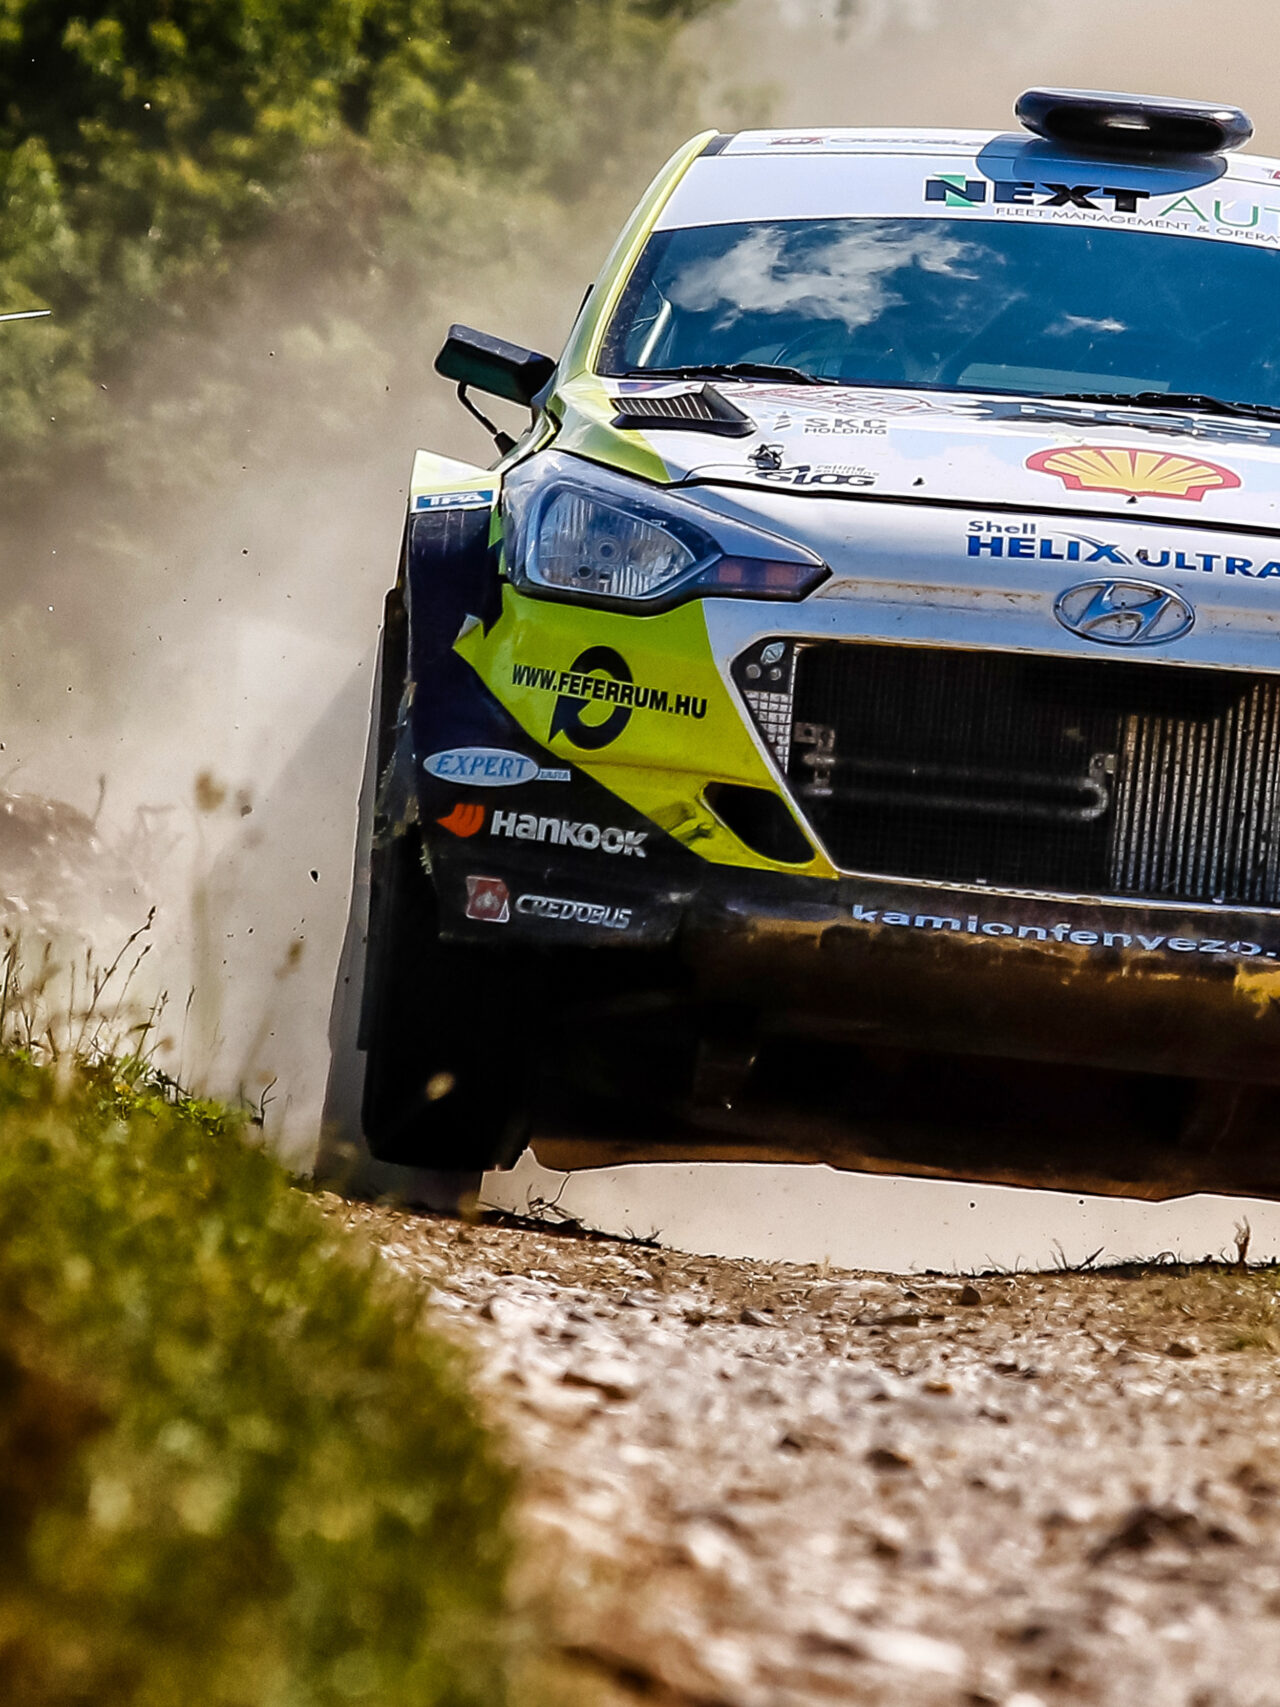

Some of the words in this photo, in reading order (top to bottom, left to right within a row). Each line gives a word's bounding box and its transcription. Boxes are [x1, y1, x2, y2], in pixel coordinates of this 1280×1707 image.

[925, 174, 1151, 213] NEXT
[995, 207, 1044, 218] FLEET
[1051, 208, 1191, 231] MANAGEMENT
[1197, 223, 1210, 233] &
[804, 427, 887, 435] HOLDING
[805, 417, 887, 429] SKC
[967, 519, 1036, 535] Shell
[965, 531, 1134, 566] HELIX
[512, 663, 708, 720] WWW.FEFERRUM.HU
[436, 754, 530, 779] EXPERT
[515, 893, 633, 930] CREDOBUS
